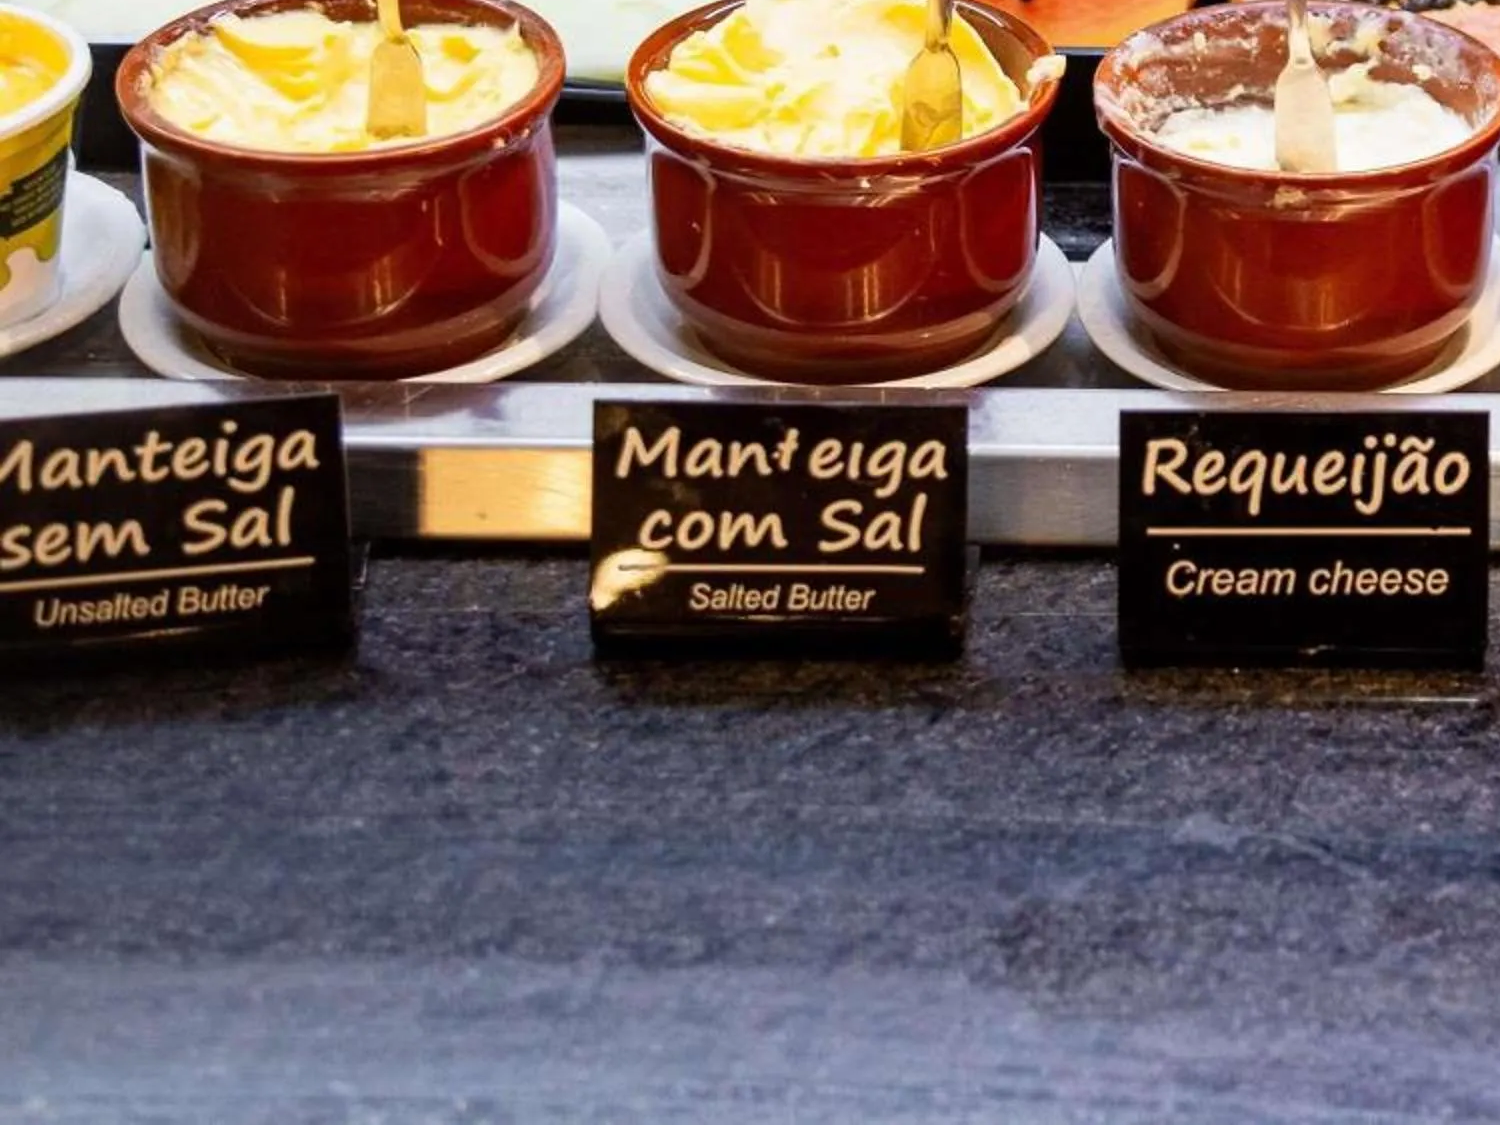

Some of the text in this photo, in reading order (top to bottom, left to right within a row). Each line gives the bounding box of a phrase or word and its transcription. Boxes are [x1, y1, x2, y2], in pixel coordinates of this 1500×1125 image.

[615, 426, 948, 498] Manteiga
[1142, 433, 1472, 516] Requeijão
[0, 486, 295, 569] sem Sal
[639, 492, 928, 553] com Sal
[34, 584, 271, 626] Unsalted Butter
[689, 582, 876, 611] Salted Butter
[1165, 559, 1450, 596] Cream cheese
